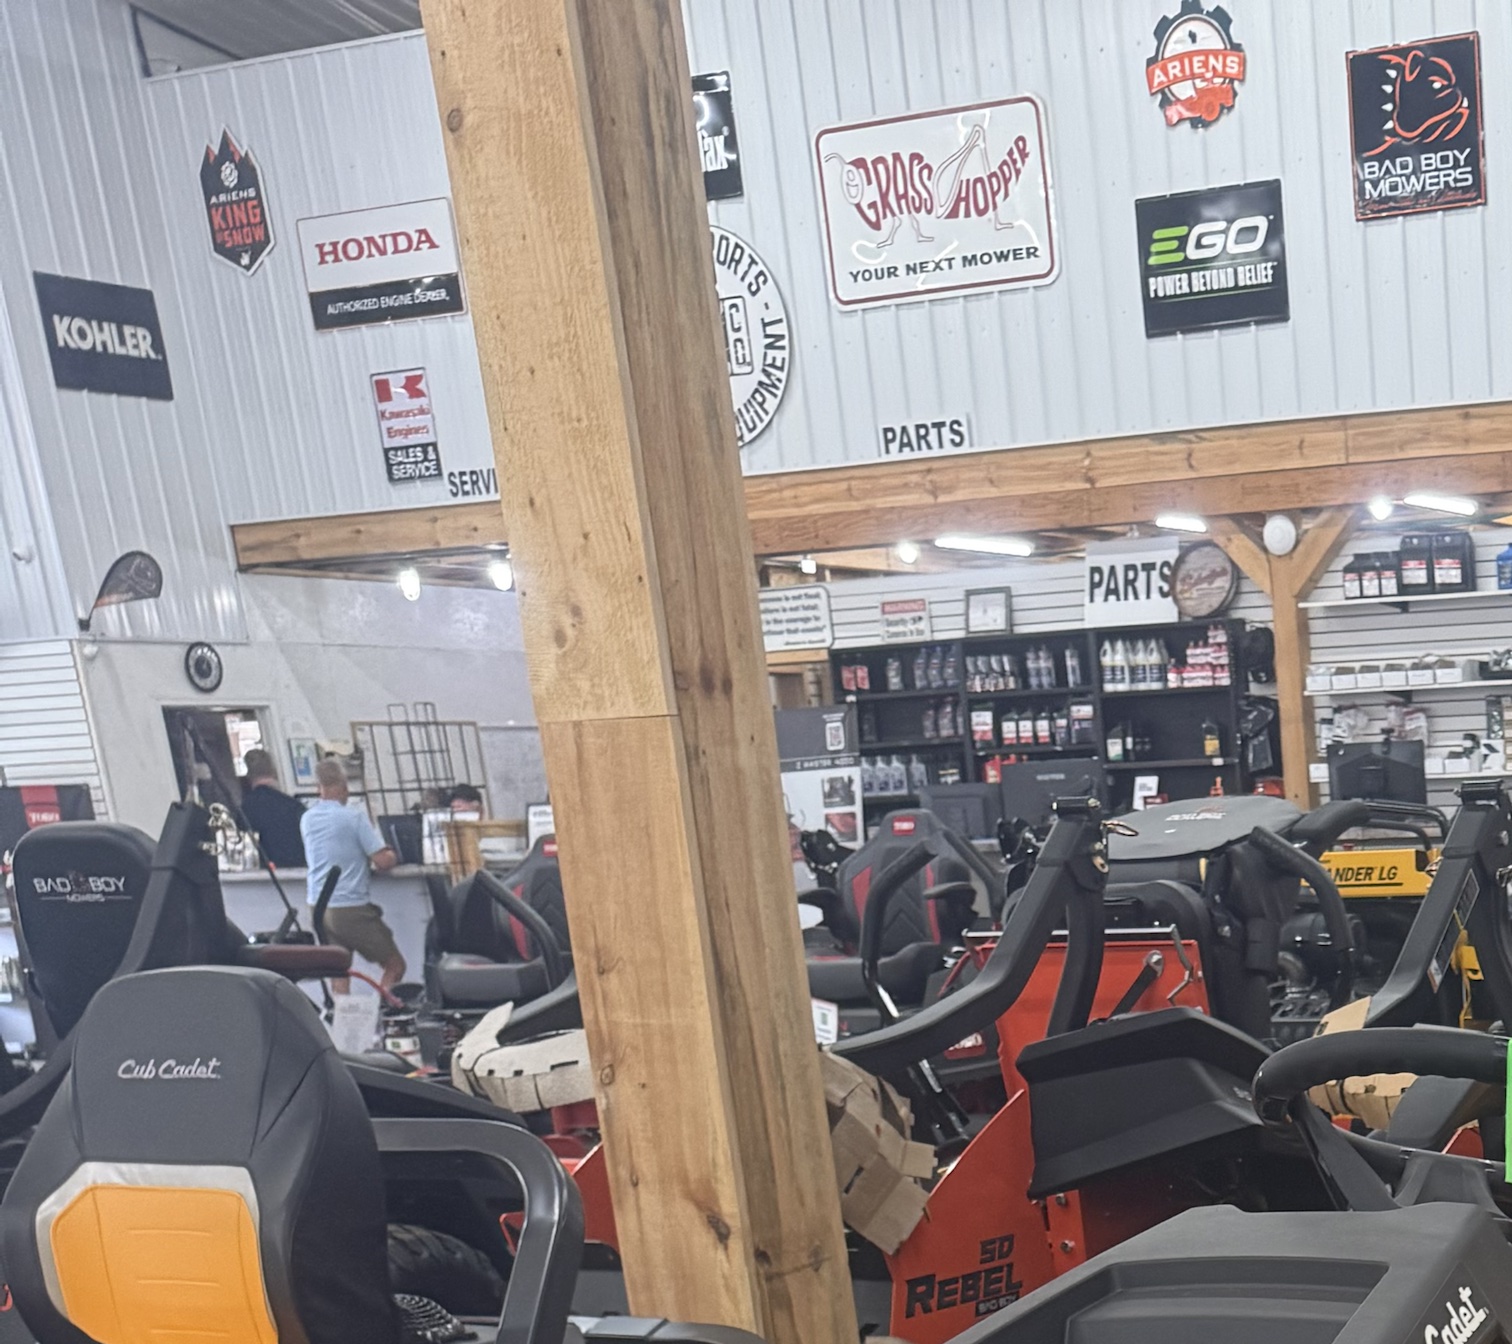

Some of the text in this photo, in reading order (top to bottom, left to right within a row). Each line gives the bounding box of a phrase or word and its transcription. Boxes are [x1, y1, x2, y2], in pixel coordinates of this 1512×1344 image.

[1153, 55, 1240, 88] ARIENS
[1363, 148, 1472, 179] BAD BOY
[209, 187, 257, 205] ARIENS
[1364, 167, 1473, 200] MOWERS
[210, 199, 262, 230] KING
[223, 223, 265, 248] SNOW
[314, 227, 440, 266] HONDA
[1147, 215, 1269, 266] EGO
[849, 246, 1041, 284] YOUR NEXT MOWER
[1148, 262, 1275, 299] POWER BEYOND BELIEF
[326, 296, 380, 316] AUTHORIZED
[380, 292, 414, 310] ENGINE
[52, 313, 158, 360] KOHLER
[379, 403, 431, 421] Kawasaki
[386, 425, 430, 439] Engines
[882, 419, 965, 455] PARTS
[388, 446, 437, 464] SALES &
[392, 461, 440, 480] SERVICE
[1088, 561, 1173, 603] PARTS
[33, 876, 126, 893] BAD BOY
[1377, 866, 1398, 881] LG
[117, 1057, 220, 1080] Cub Cadet
[905, 1262, 1023, 1319] REBEL
